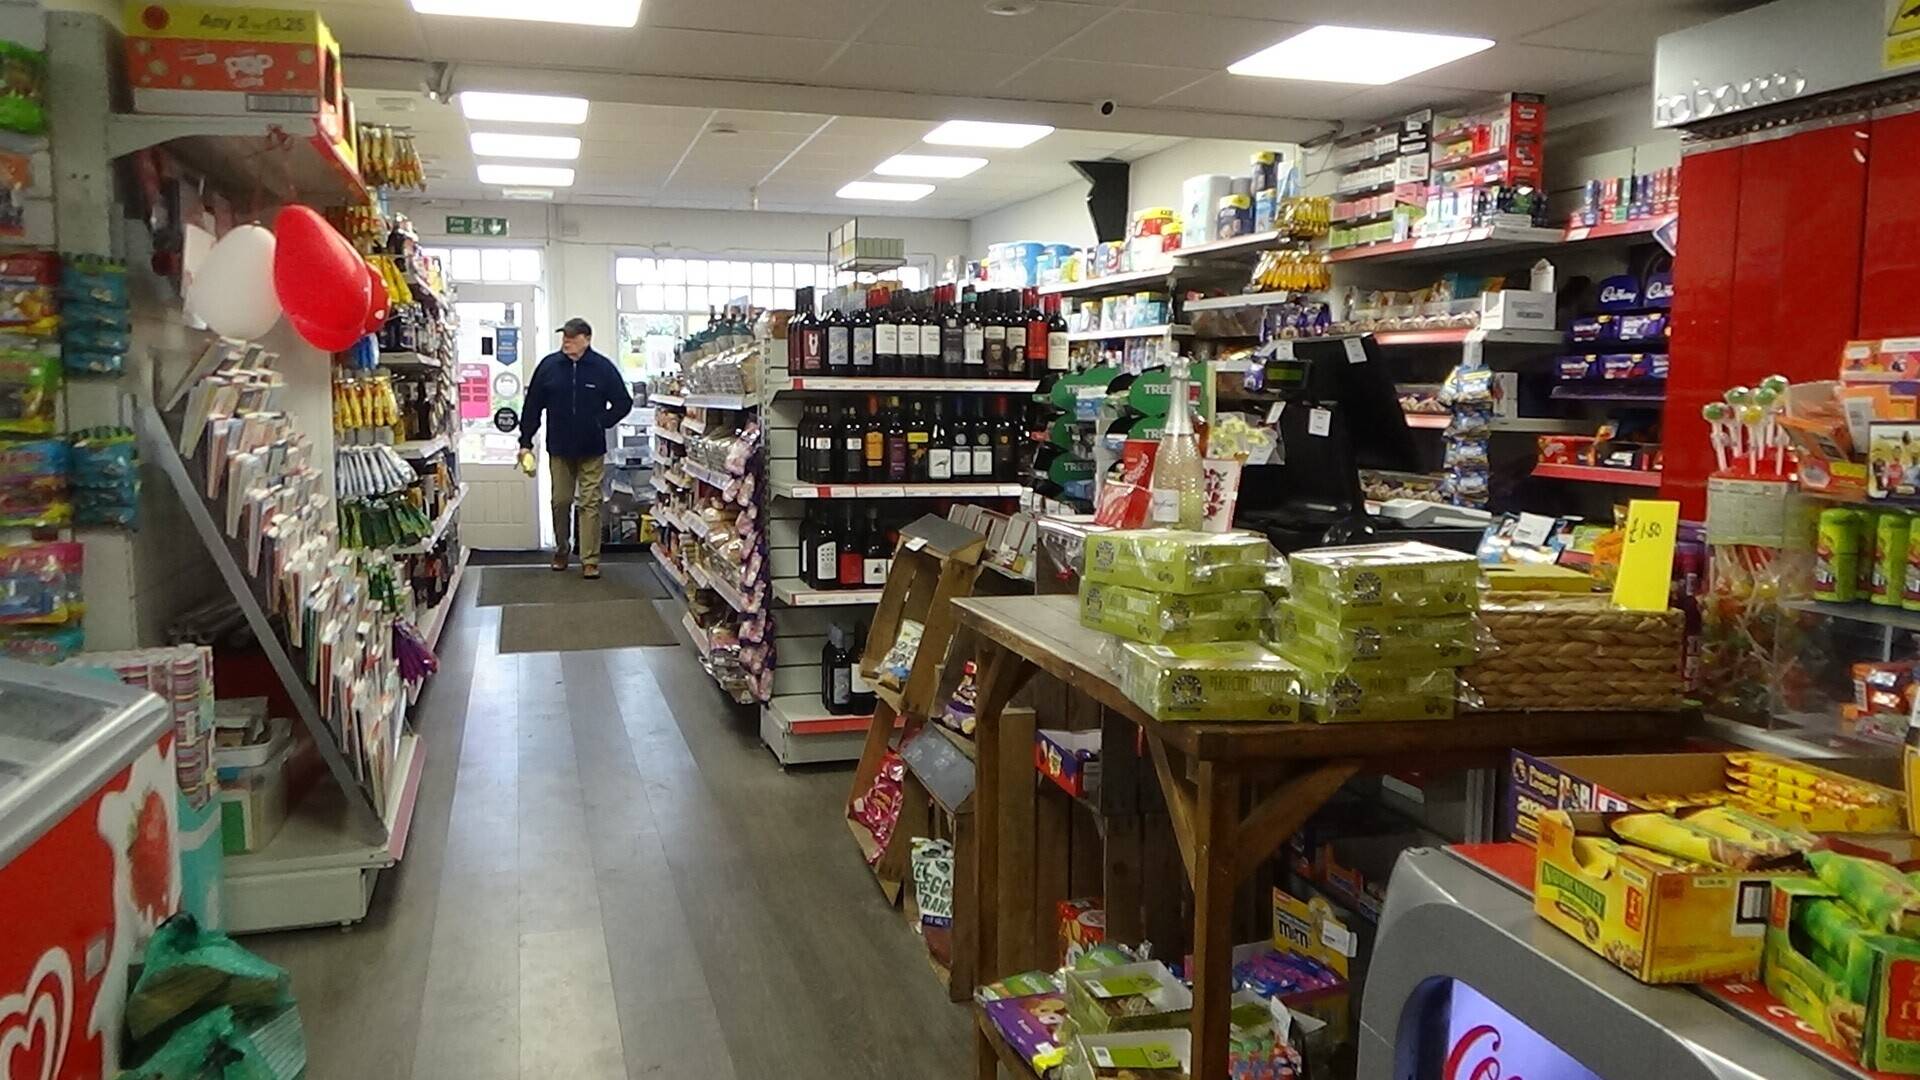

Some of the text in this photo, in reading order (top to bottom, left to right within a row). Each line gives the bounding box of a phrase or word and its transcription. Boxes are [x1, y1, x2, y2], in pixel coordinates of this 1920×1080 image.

[201, 14, 232, 30] Any
[238, 15, 249, 29] 2
[1655, 72, 1808, 126] tobacco
[1600, 286, 1637, 303] Cadbury
